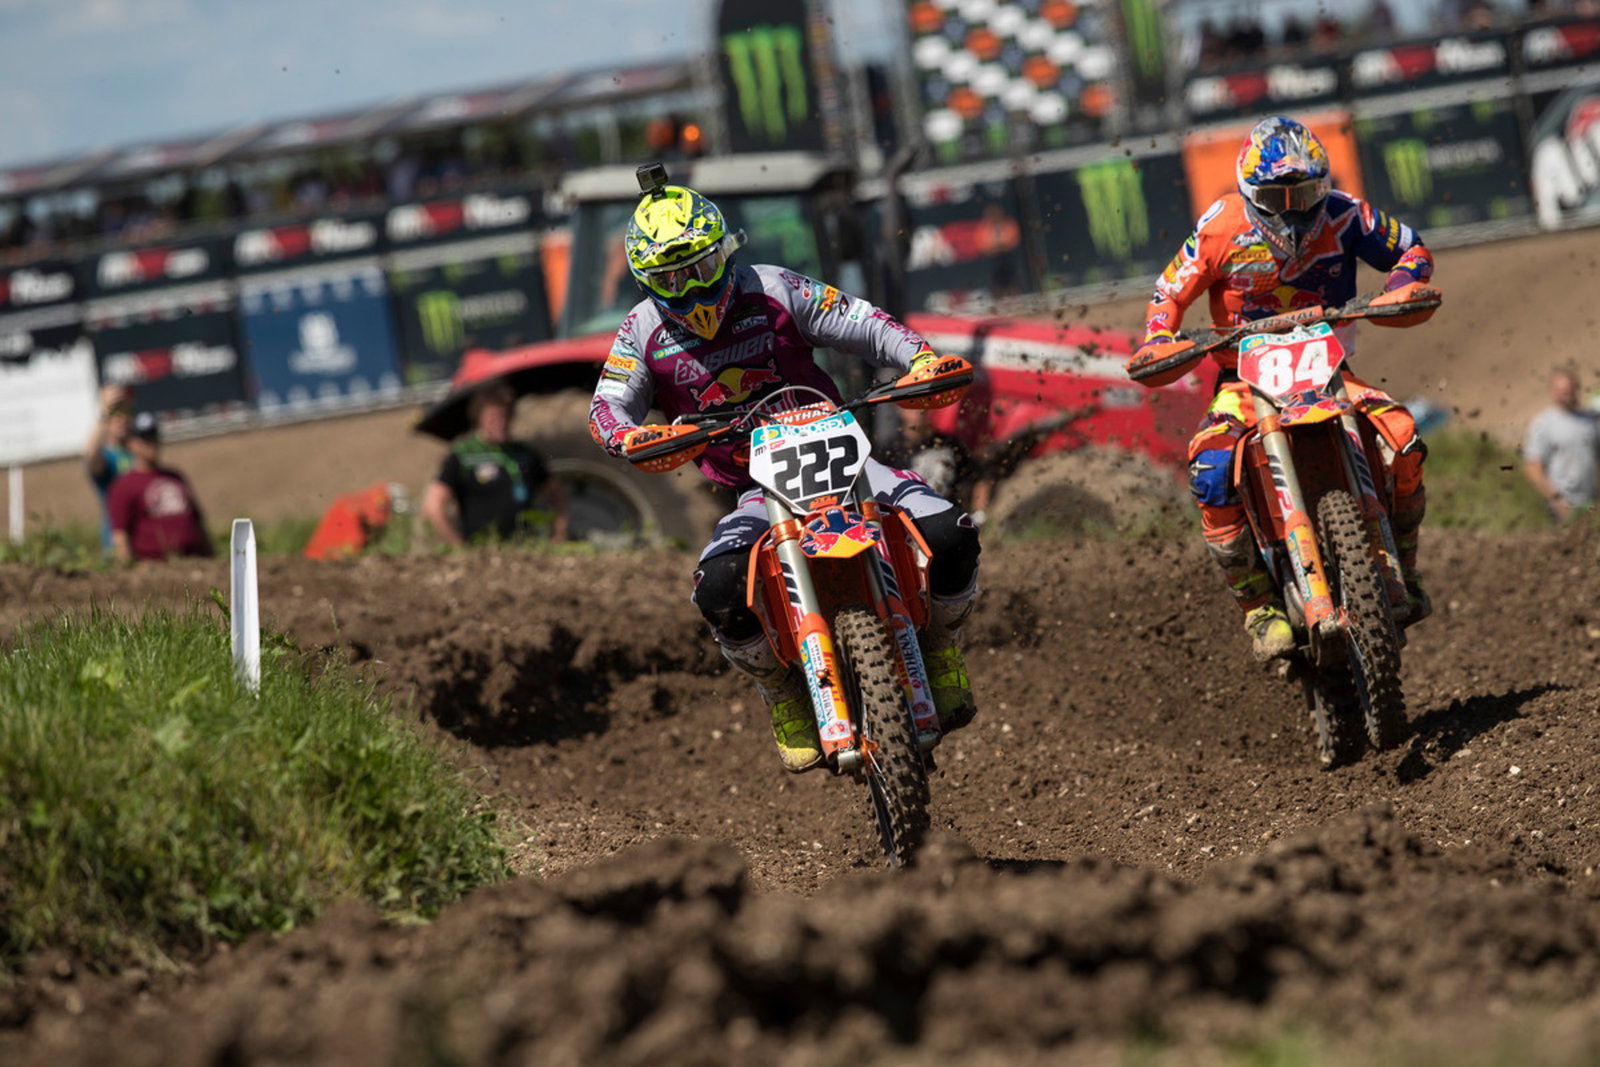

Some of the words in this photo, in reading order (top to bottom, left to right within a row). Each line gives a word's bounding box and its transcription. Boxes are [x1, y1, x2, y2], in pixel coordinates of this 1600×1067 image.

[933, 358, 963, 375] KTM
[1258, 340, 1333, 398] 84
[632, 431, 663, 446] KTM
[770, 434, 859, 501] 222
[897, 633, 919, 680] ATHENA
[805, 664, 826, 723] MOTOREX
